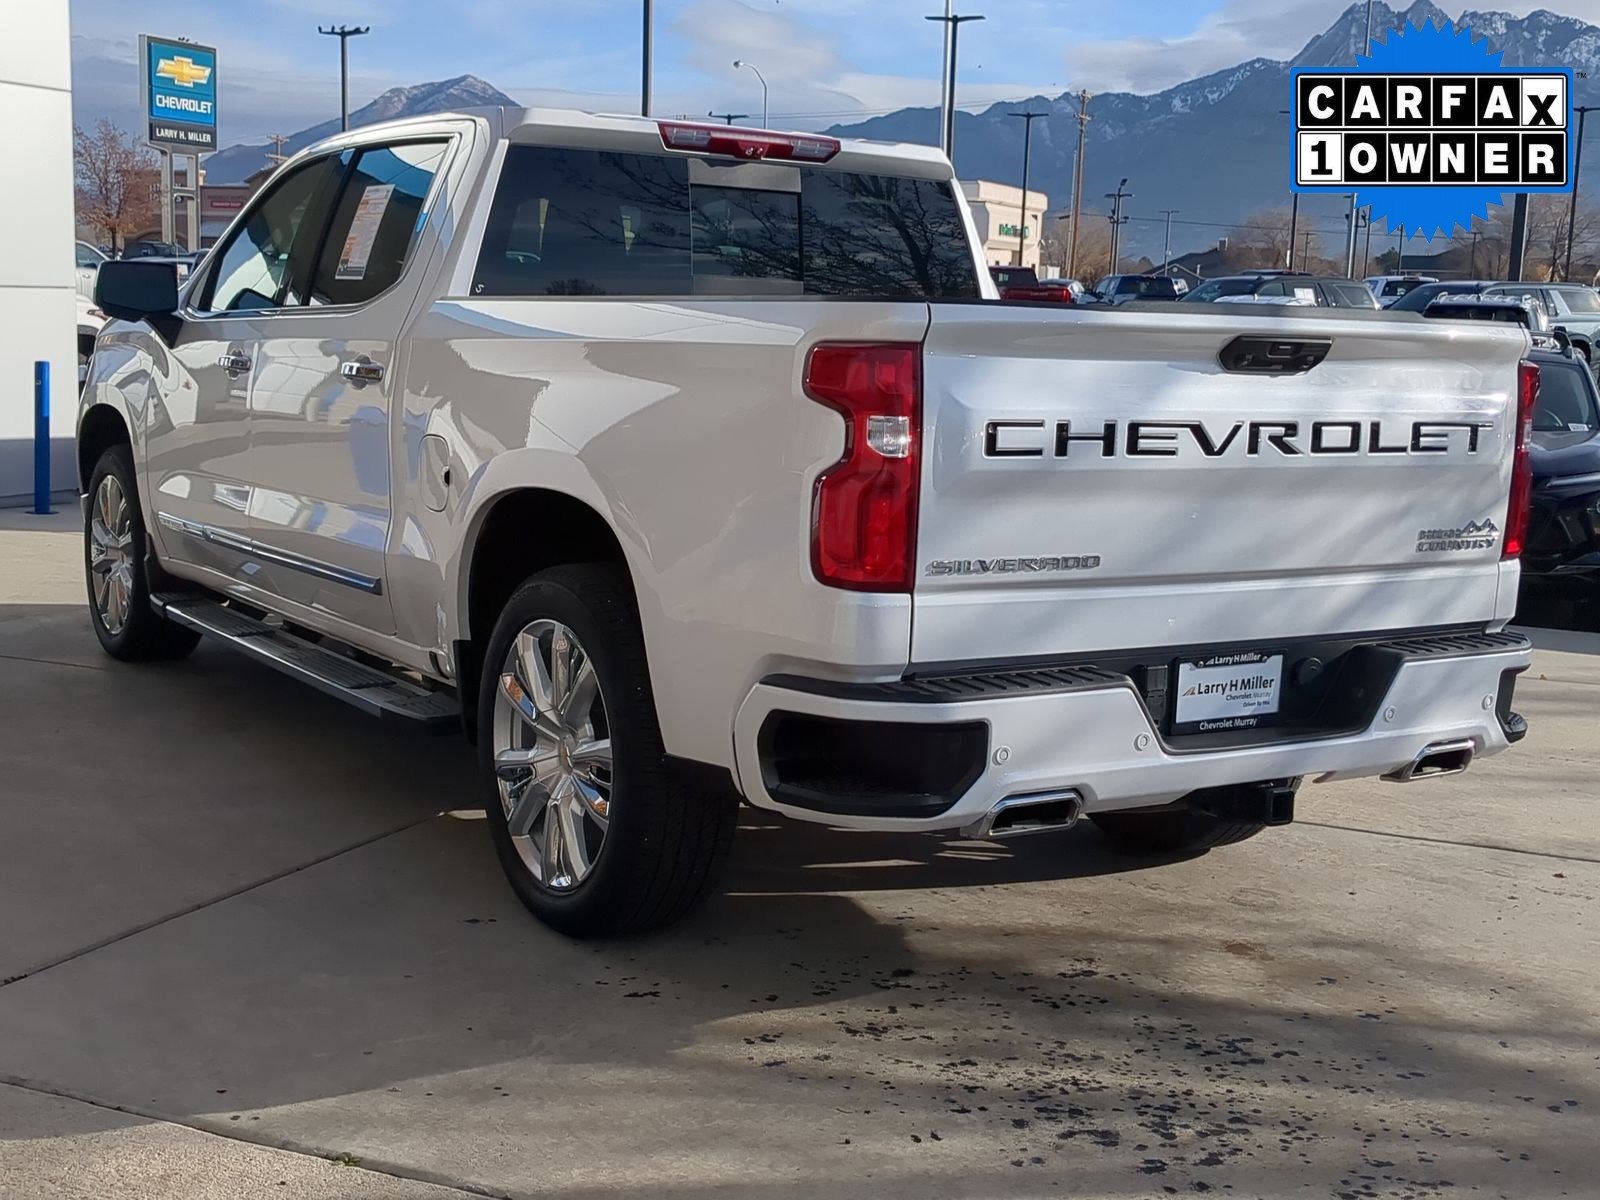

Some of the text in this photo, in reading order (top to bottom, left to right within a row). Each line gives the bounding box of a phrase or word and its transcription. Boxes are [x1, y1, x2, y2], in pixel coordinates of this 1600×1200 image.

[155, 94, 212, 114] CHEVROLET
[156, 127, 211, 143] LARRY H. MILLER
[984, 418, 1494, 458] CHEVROLET
[1416, 538, 1496, 553] COUNTRY
[928, 554, 1101, 576] SILVERADO
[1215, 652, 1261, 665] Larry H Miller
[1198, 676, 1274, 696] Larry H Miller
[1226, 693, 1251, 701] Chevrolet
[1200, 717, 1258, 731] Chevrolet Murray
